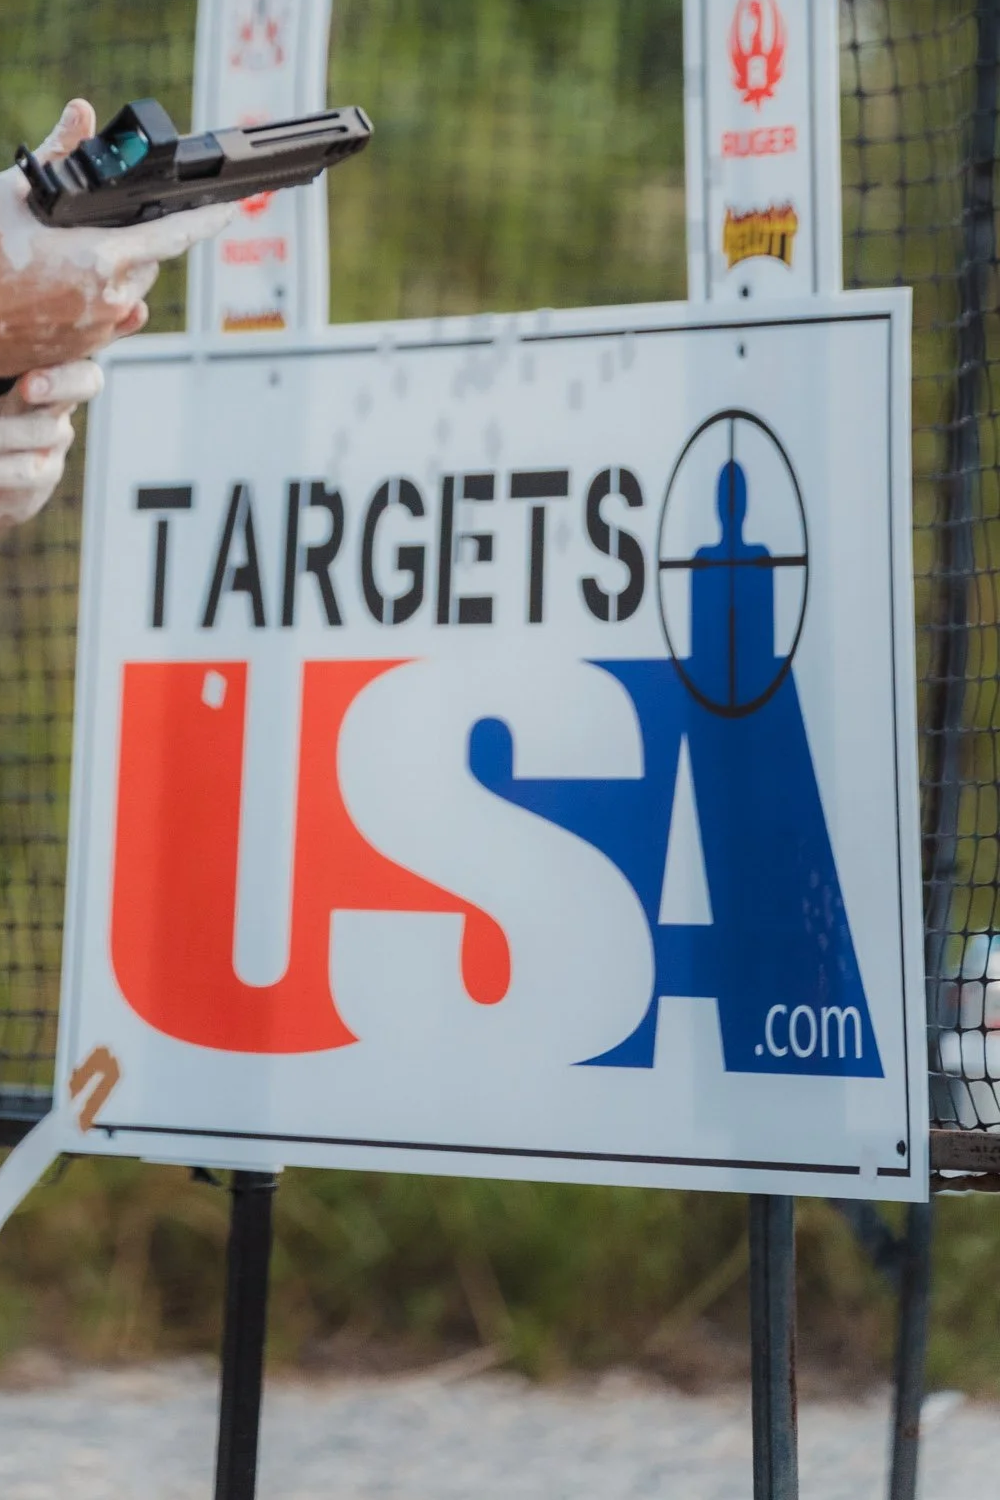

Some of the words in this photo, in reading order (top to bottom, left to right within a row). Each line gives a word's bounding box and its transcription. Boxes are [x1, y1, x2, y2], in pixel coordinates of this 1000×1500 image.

[722, 124, 797, 159] RUGER
[137, 466, 647, 628] TARGETS
[109, 656, 885, 1079] USA
[755, 1003, 863, 1059] .com
